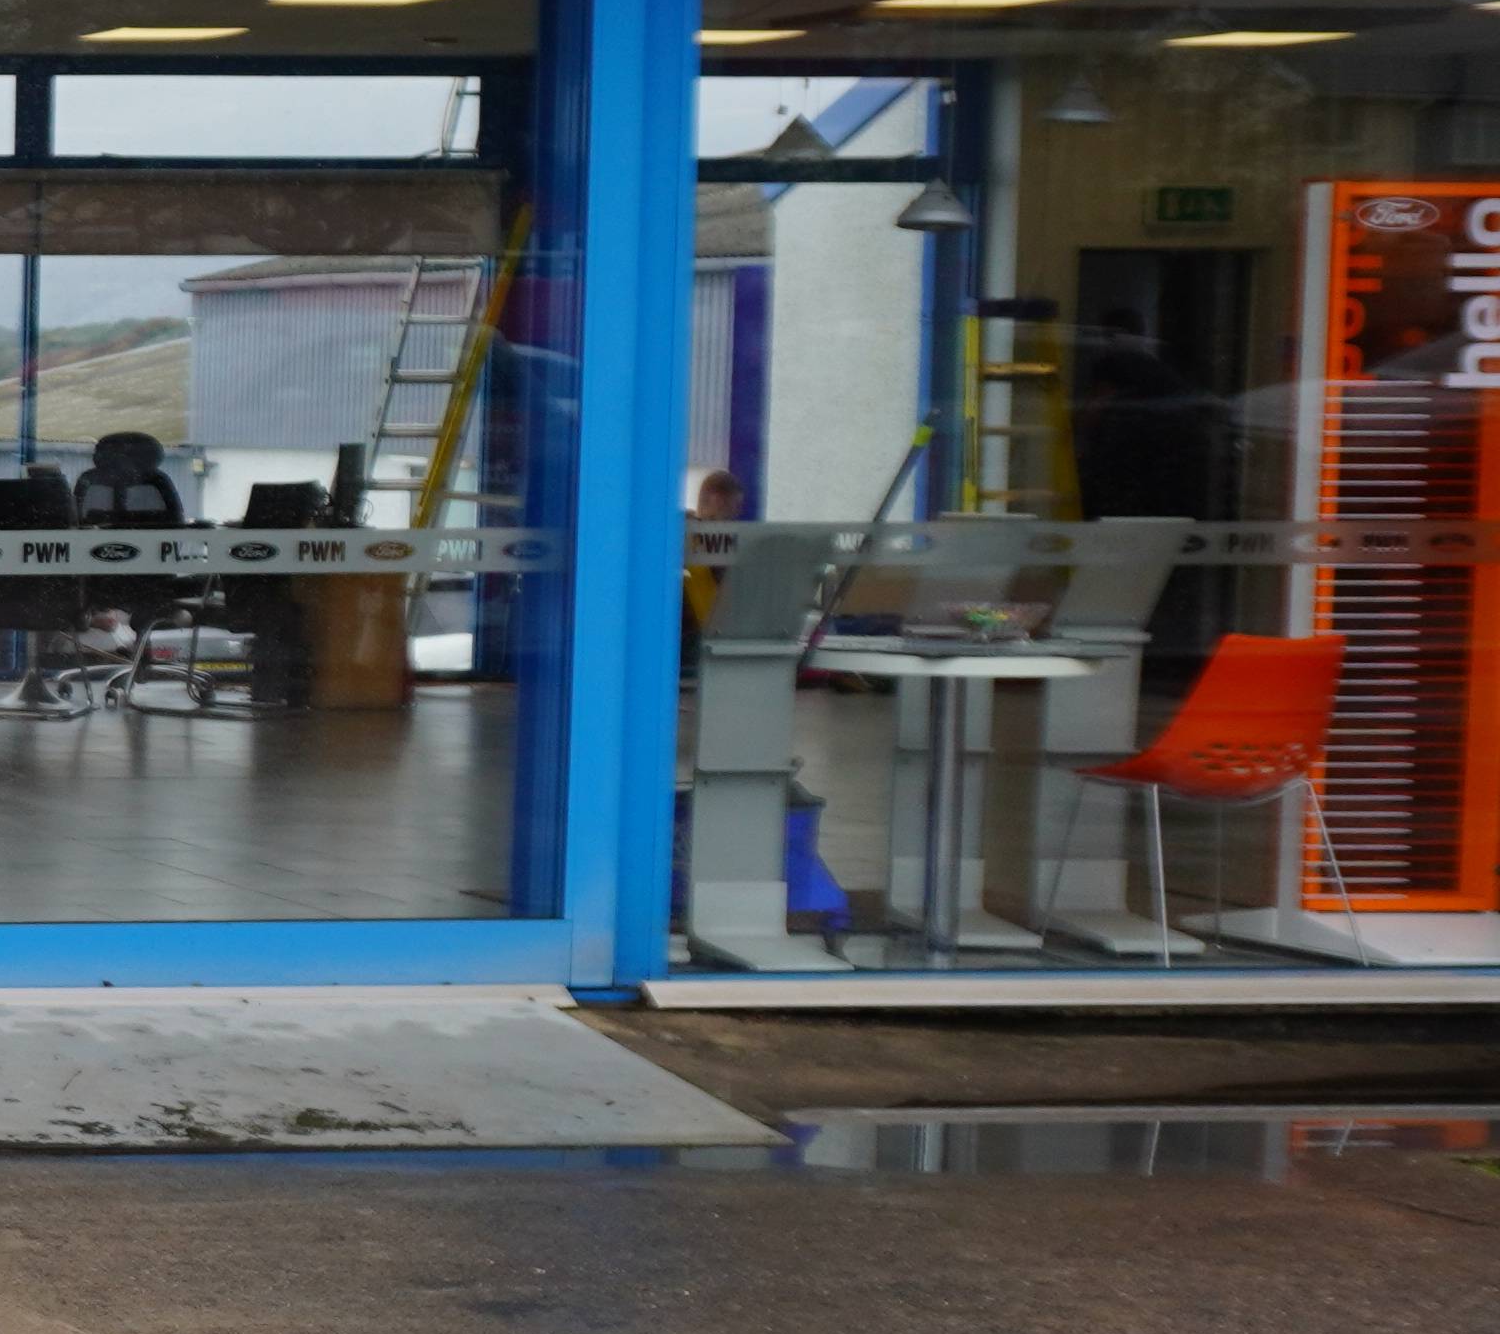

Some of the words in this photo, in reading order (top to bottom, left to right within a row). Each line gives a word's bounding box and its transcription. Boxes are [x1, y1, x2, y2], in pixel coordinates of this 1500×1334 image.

[1366, 200, 1429, 227] Ford
[1445, 198, 1500, 387] hello
[22, 542, 71, 563] PWM
[298, 540, 346, 562] PWM
